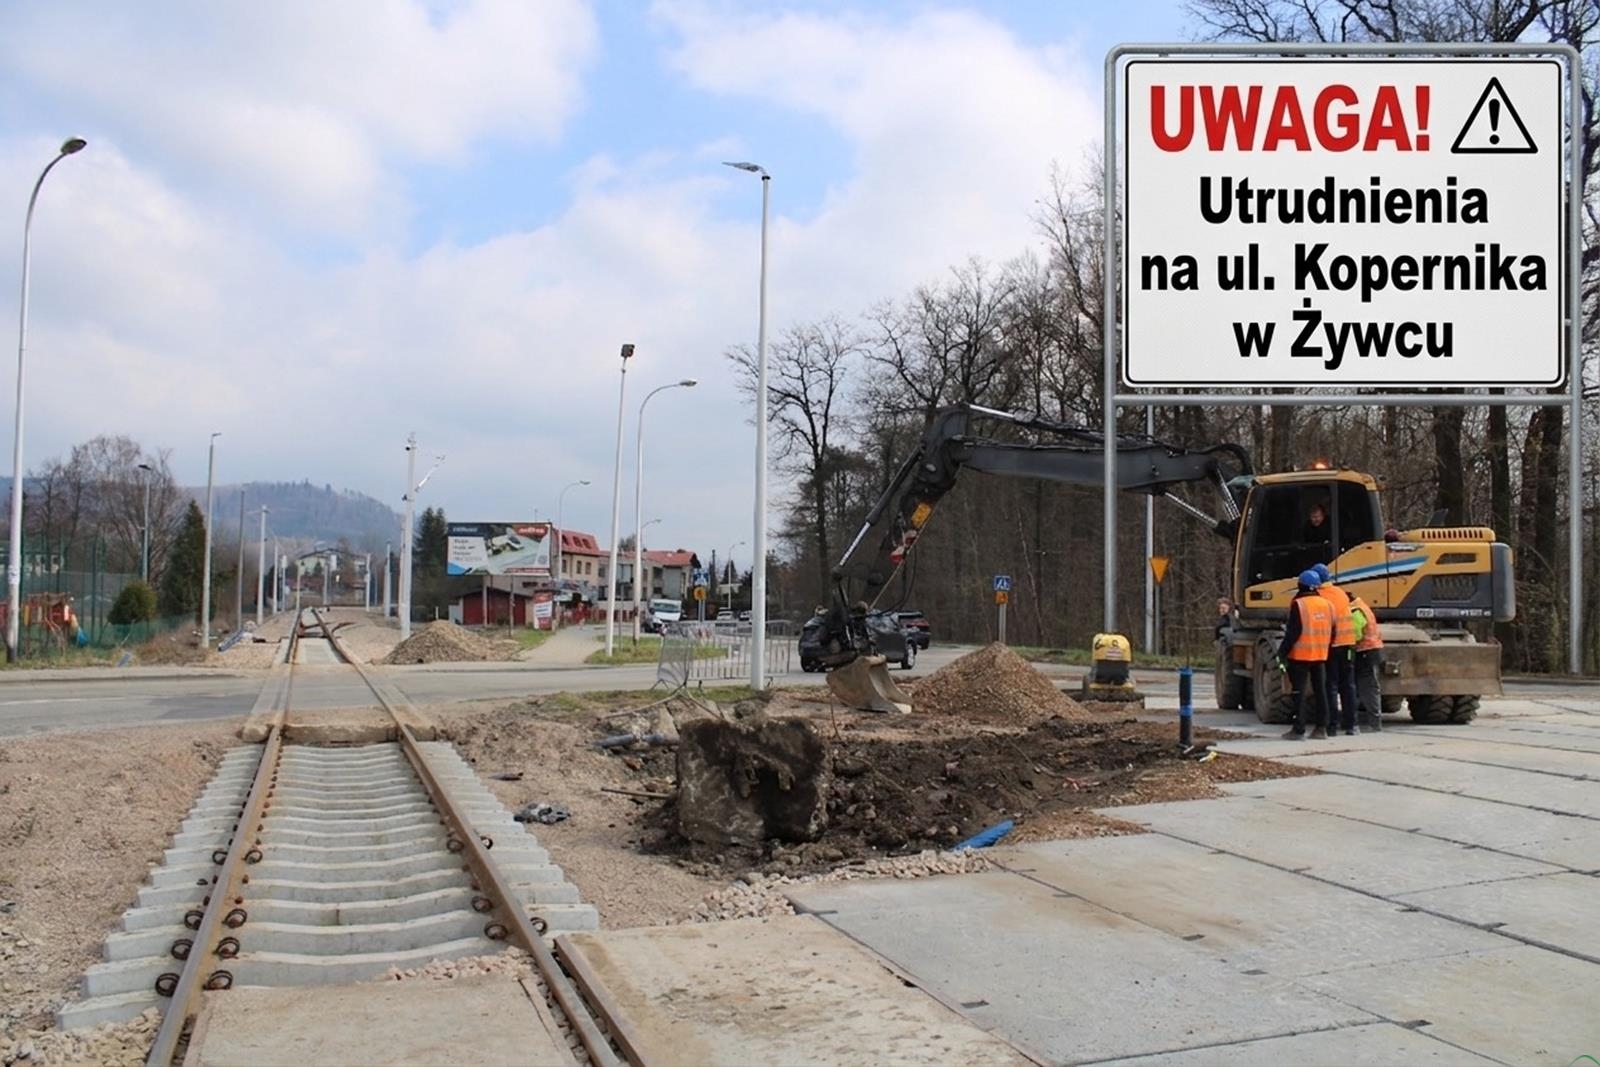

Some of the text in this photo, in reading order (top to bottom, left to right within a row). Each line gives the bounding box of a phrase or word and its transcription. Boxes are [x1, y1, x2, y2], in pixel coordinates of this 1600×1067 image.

[1150, 84, 1430, 153] UWAGA!
[1200, 176, 1489, 225] Utrudnienia
[1141, 243, 1548, 302] na ul. Kopernika
[1233, 297, 1454, 370] w Żywcu
